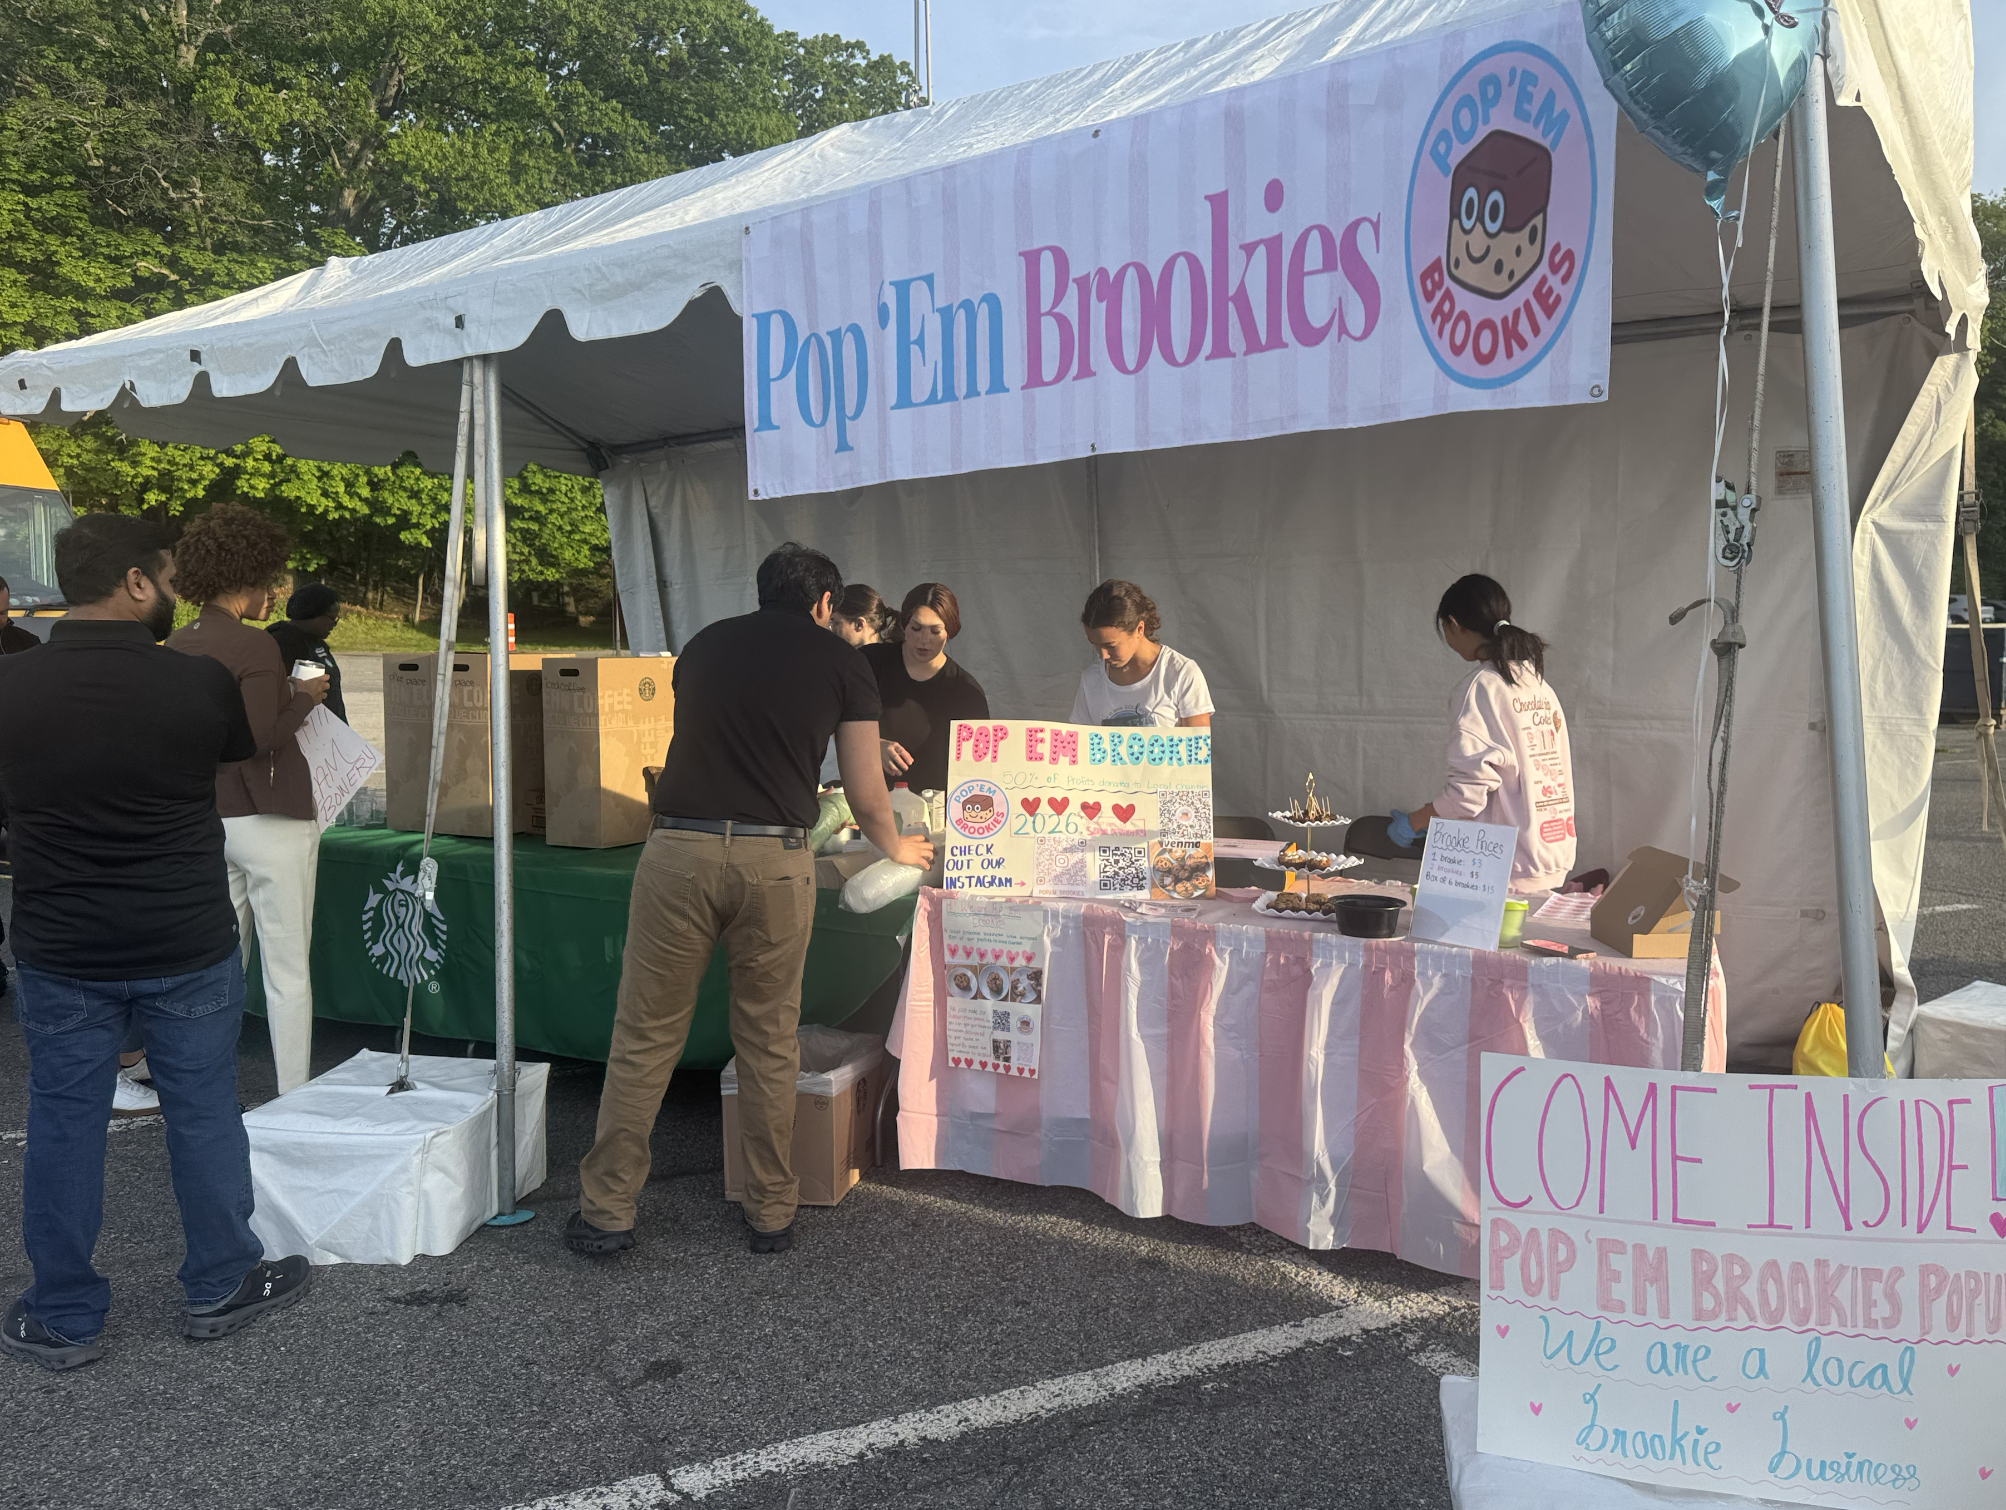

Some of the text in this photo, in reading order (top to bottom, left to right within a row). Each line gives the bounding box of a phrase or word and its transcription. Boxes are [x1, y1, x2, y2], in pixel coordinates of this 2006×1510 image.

[1430, 66, 1570, 177] POP'EM
[752, 308, 868, 455] Pop
[1019, 178, 1382, 391] Brookies
[1419, 241, 1576, 366] BROOKIES
[955, 723, 1211, 767] POP EM BROOKIES
[320, 744, 377, 823] BOWERY
[954, 784, 997, 803] POP'EM
[1003, 771, 1038, 786] 50%
[1047, 772, 1060, 783] of
[955, 811, 1005, 835] BROOKIES
[1433, 822, 1504, 855] Brookie Prices
[946, 857, 1006, 871] OUT OUR
[950, 843, 994, 857] CHECK
[945, 875, 1013, 890] INSTAGRAM
[1482, 883, 1495, 894] $15
[1485, 1066, 1718, 1227] COME
[1487, 1217, 1577, 1301] POP
[1691, 1248, 1905, 1330] BROOKIES
[1539, 1315, 1916, 1396] We are a local
